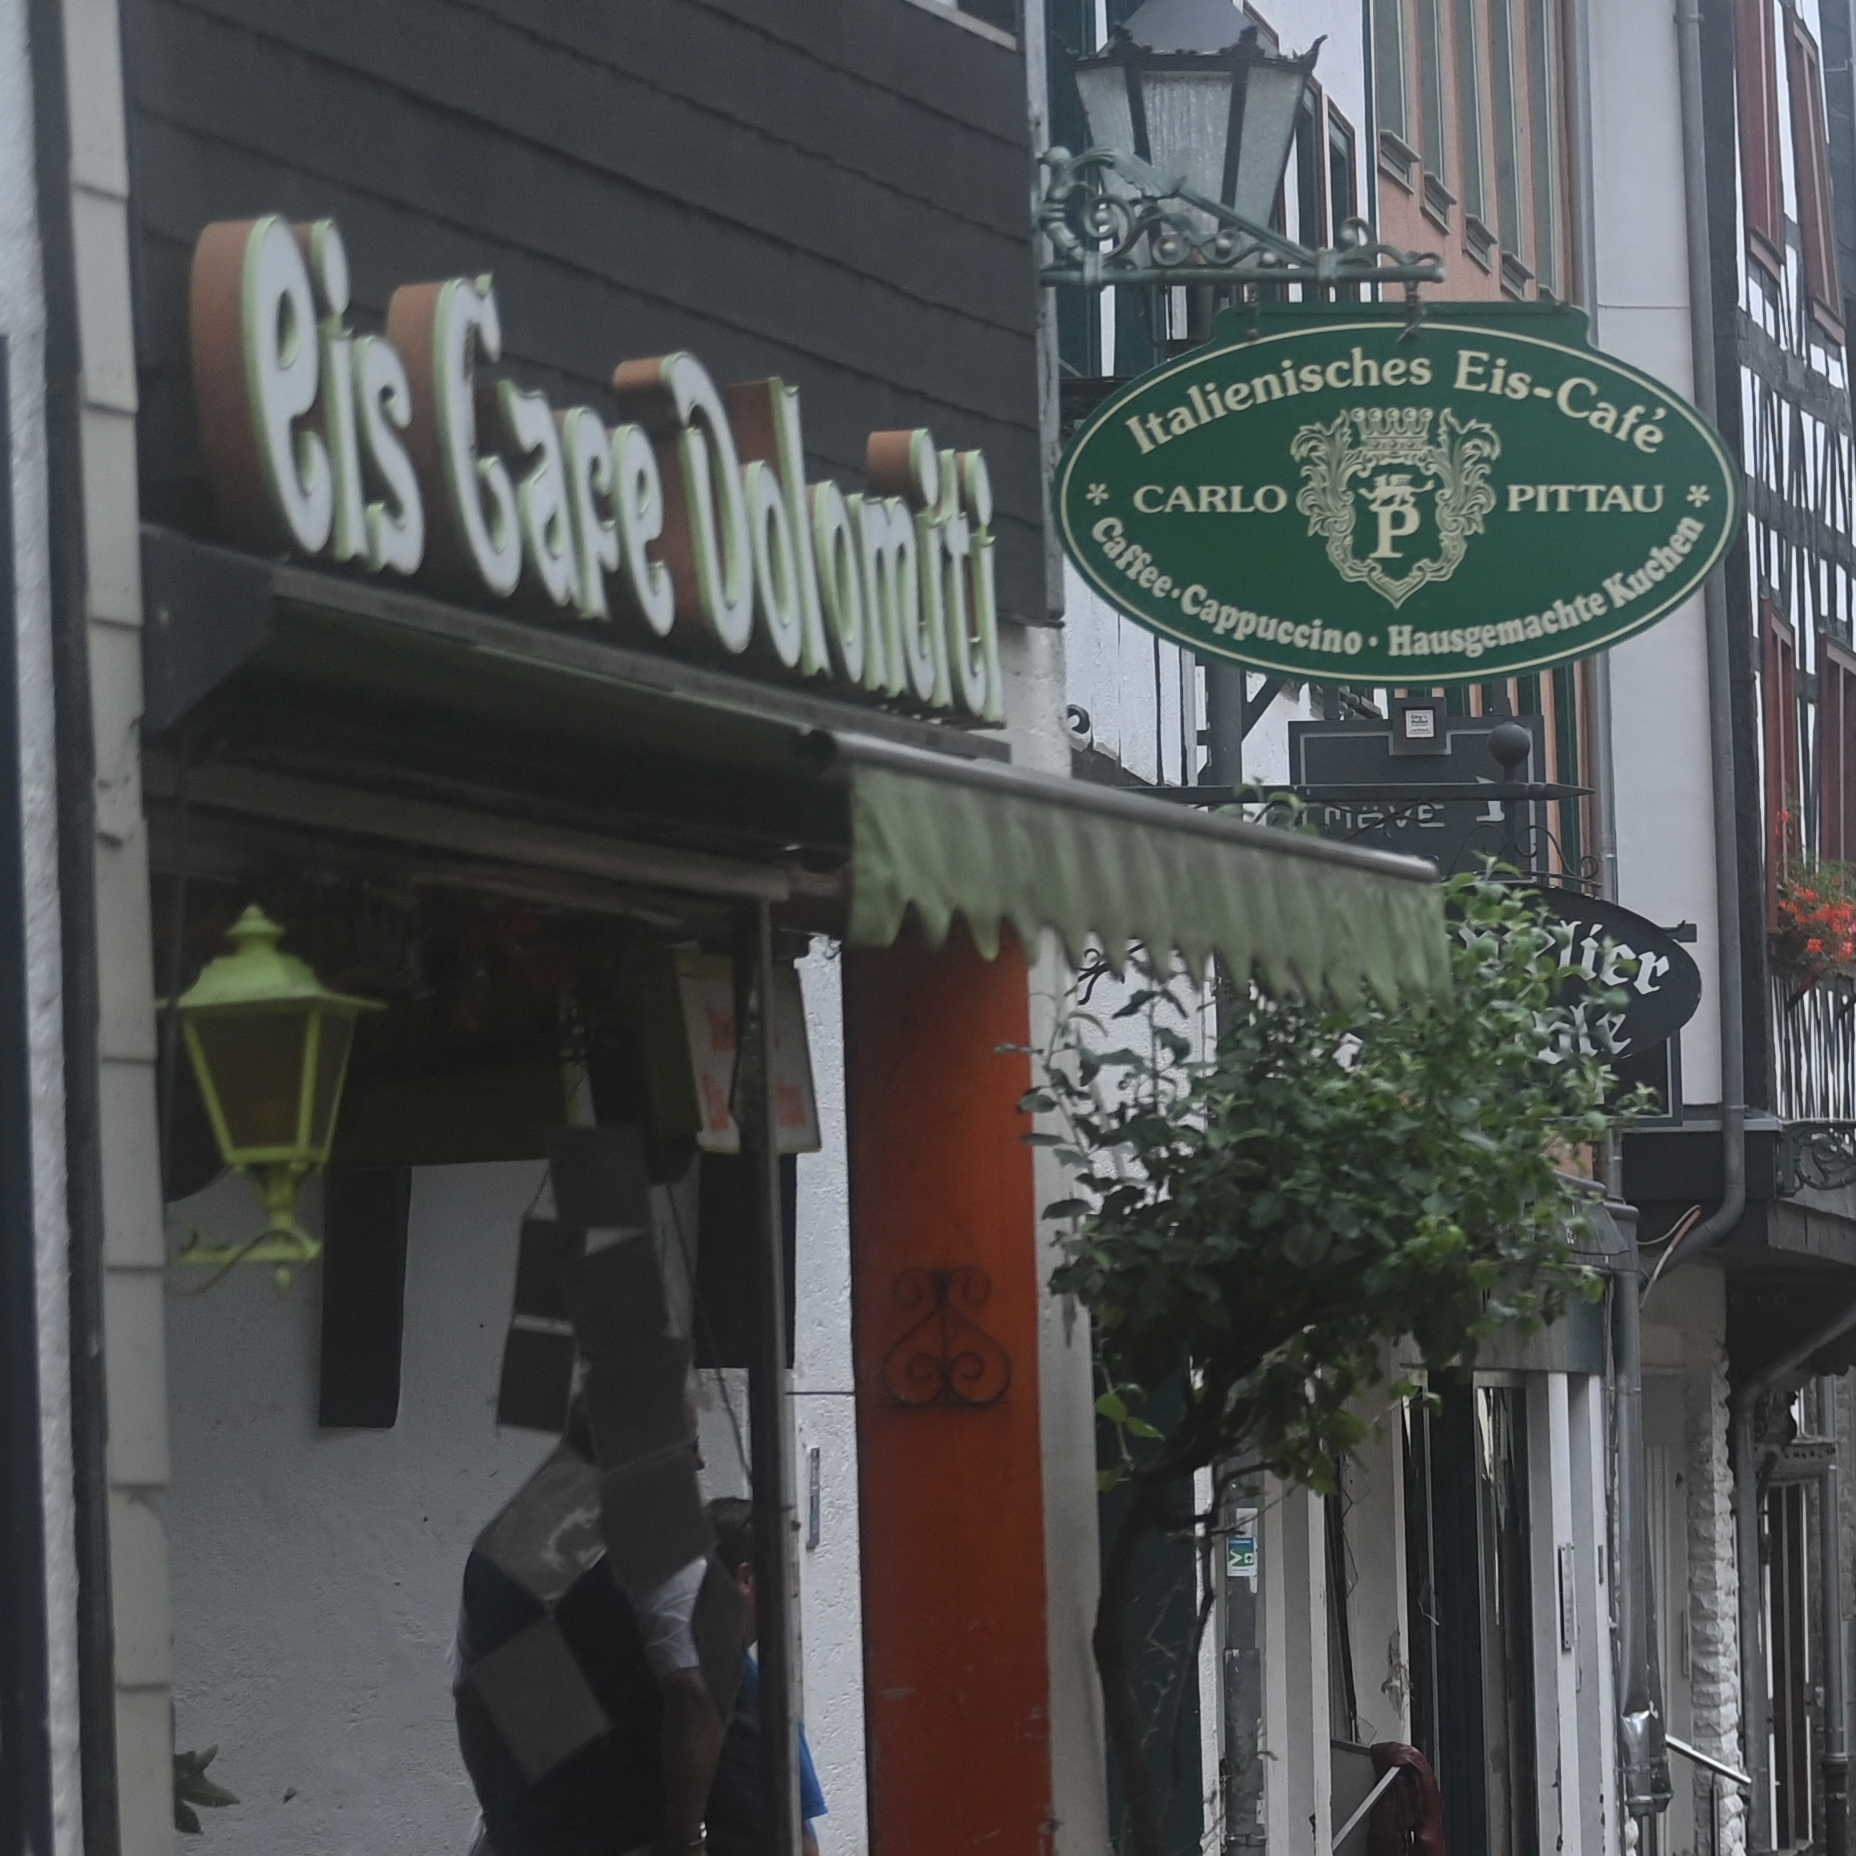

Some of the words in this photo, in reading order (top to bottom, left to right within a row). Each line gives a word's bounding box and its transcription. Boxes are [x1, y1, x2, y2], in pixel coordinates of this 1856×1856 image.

[1125, 346, 1433, 455] Italienisches
[1453, 349, 1667, 454] Eis-Café
[658, 350, 1006, 727] Dolomiti
[1133, 484, 1288, 513] CARLO
[1507, 484, 1664, 513] PITTAU
[1370, 504, 1421, 560] P
[1387, 590, 1609, 658] Hausgemachte
[1606, 517, 1706, 610] Kuchen
